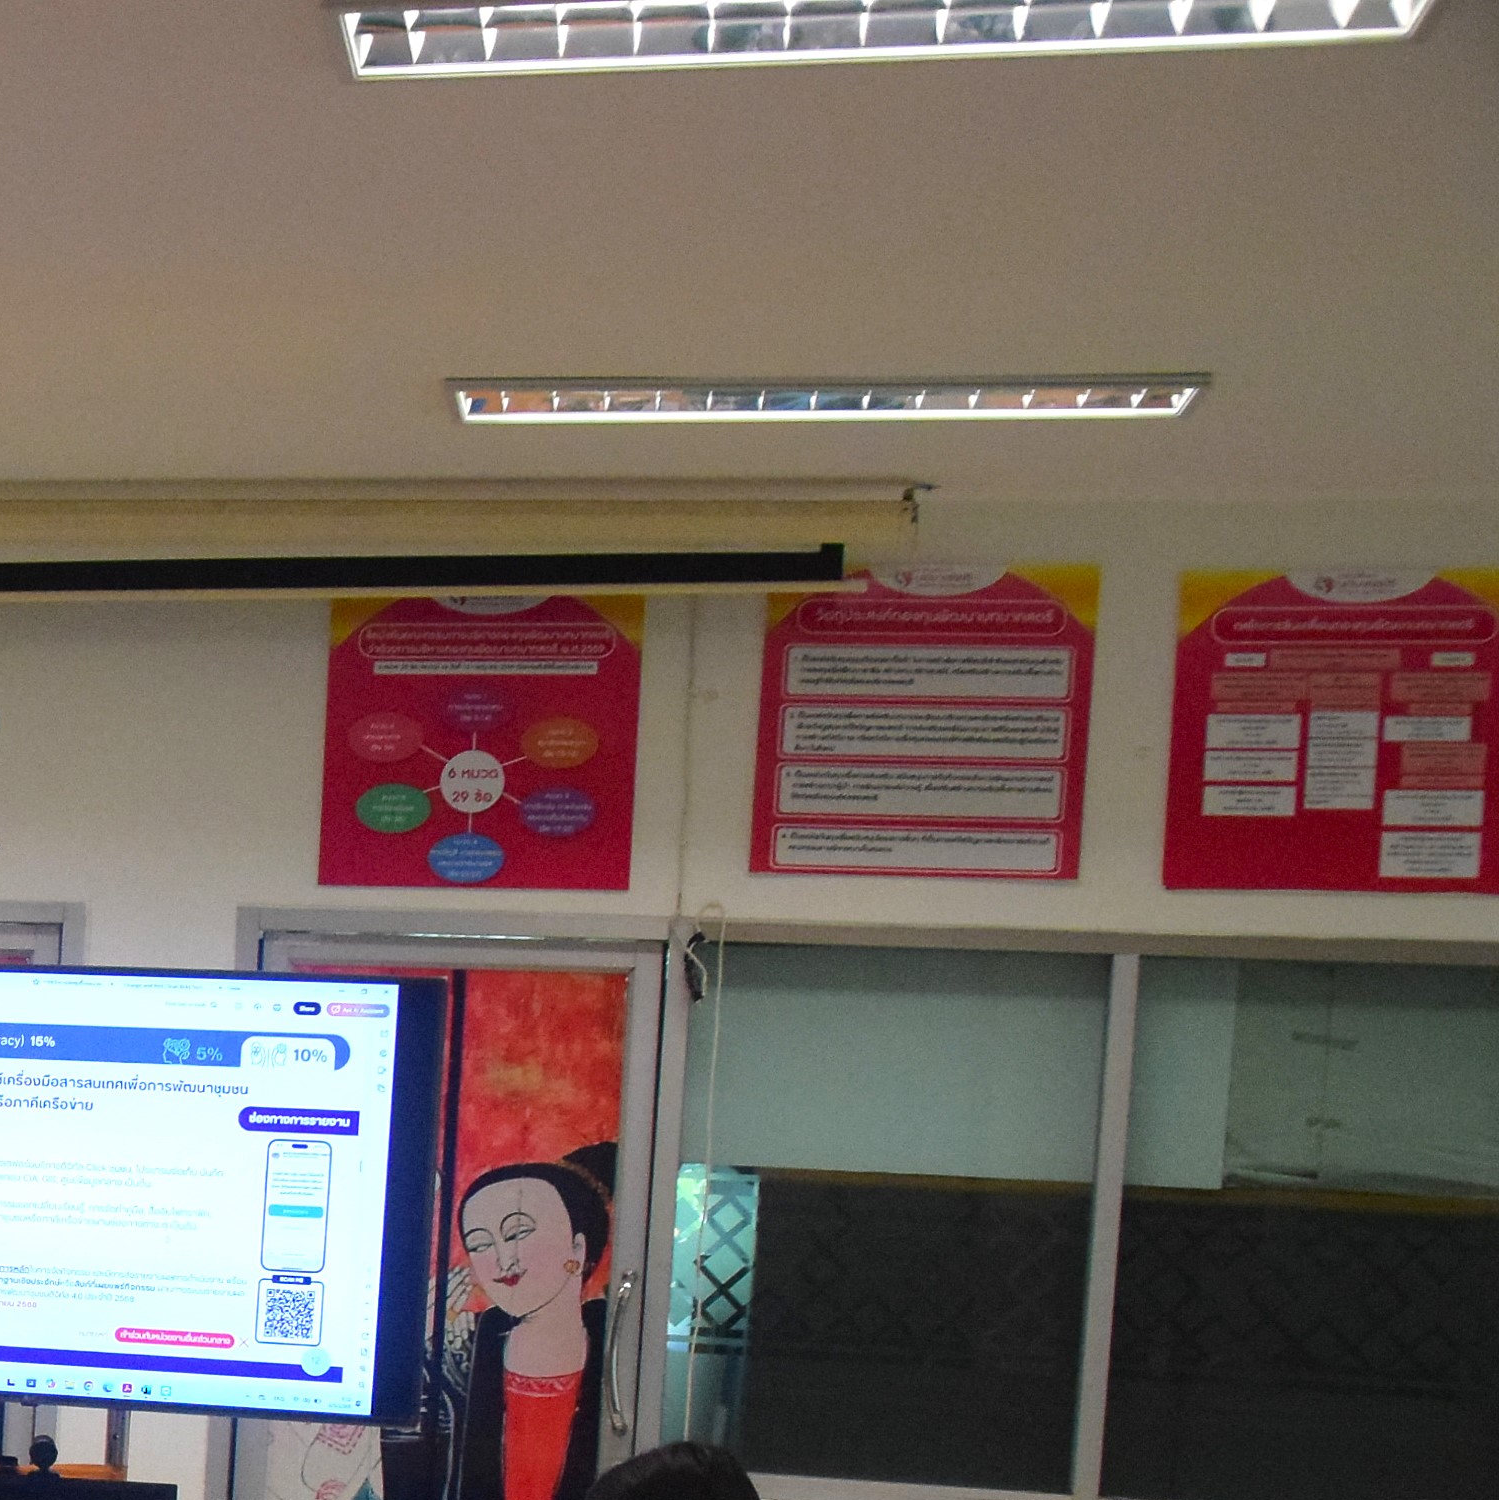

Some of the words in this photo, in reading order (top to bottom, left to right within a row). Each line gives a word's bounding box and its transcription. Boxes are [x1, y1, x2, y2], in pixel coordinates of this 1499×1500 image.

[448, 767, 456, 780] 6
[452, 790, 470, 803] 29
[30, 1035, 56, 1048] 15%
[196, 1047, 224, 1062] 5%
[293, 1048, 328, 1063] 10%
